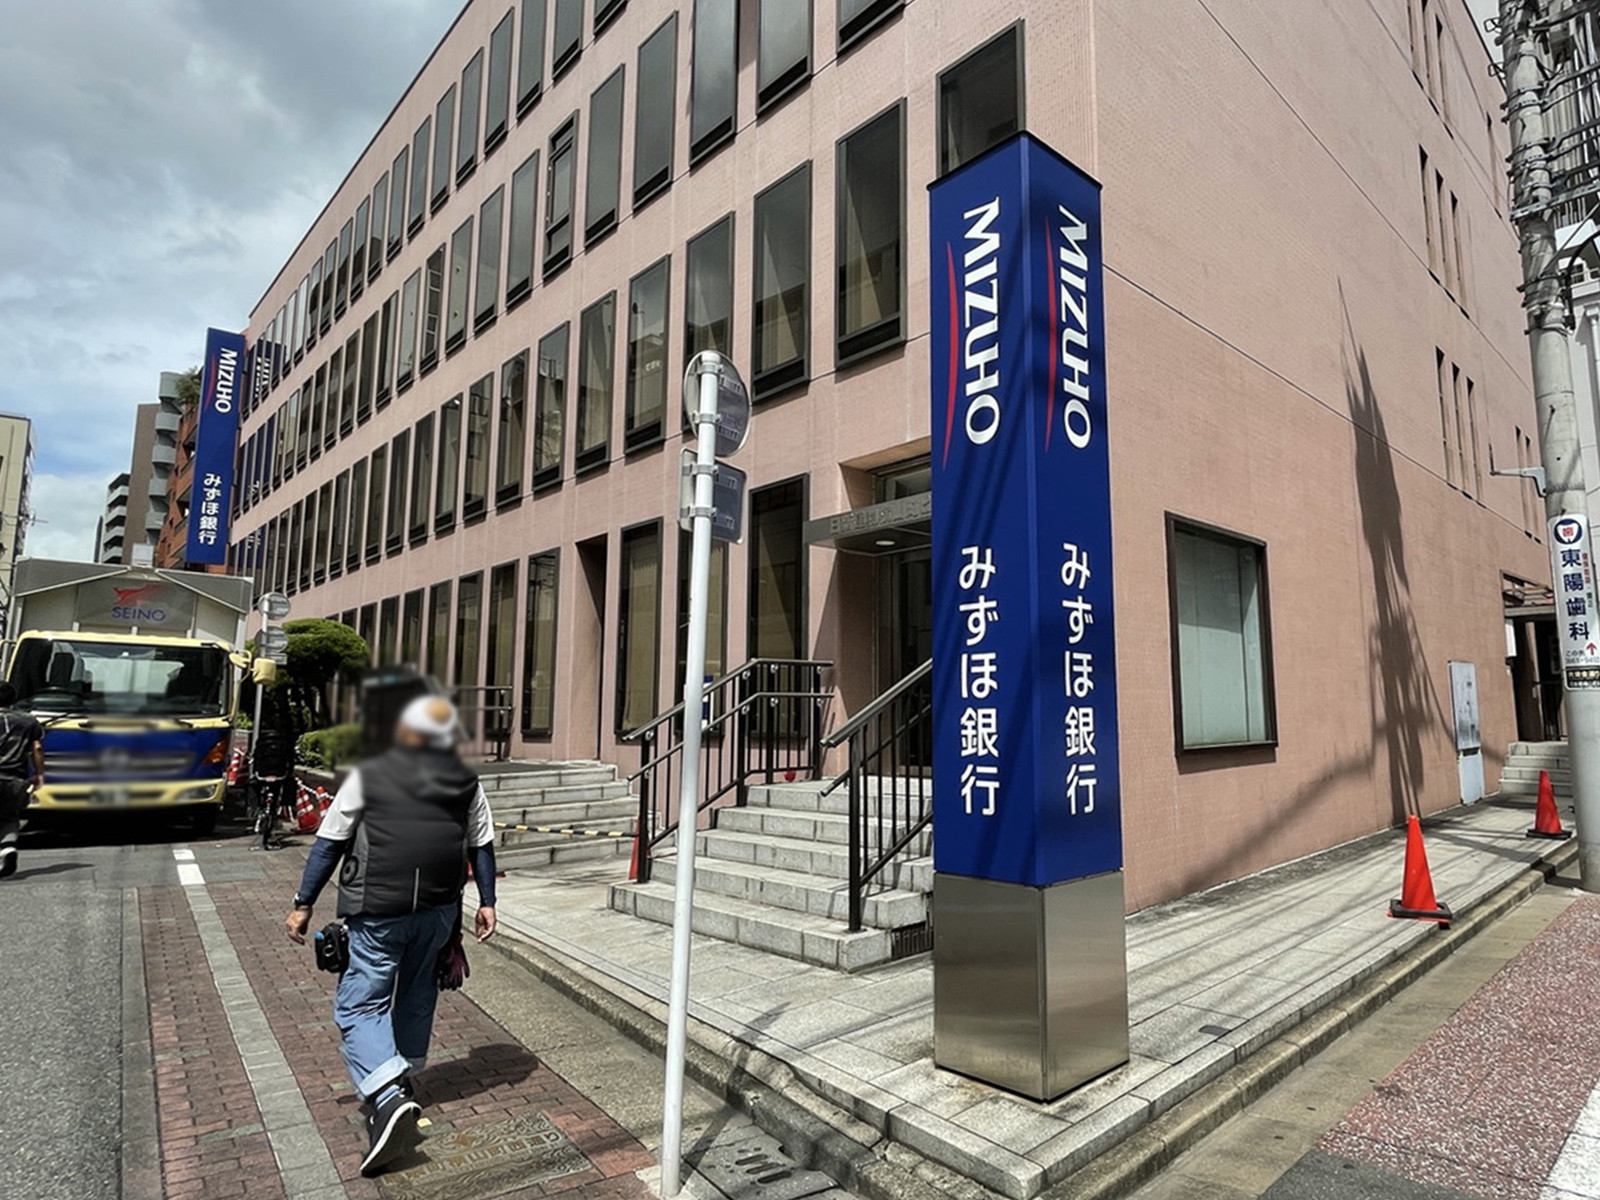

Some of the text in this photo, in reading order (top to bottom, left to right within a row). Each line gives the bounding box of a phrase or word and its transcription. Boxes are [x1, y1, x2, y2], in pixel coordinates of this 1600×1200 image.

[214, 347, 239, 413] MIZUHO
[963, 196, 1001, 445] MIZUHO
[1058, 204, 1092, 449] MIZUHO
[198, 473, 222, 545] みずほ銀行
[111, 606, 166, 621] SEINO
[1560, 548, 1590, 641] 東陽歯科
[958, 546, 1000, 816] みずほ銀行
[1061, 543, 1097, 816] みずほ銀行
